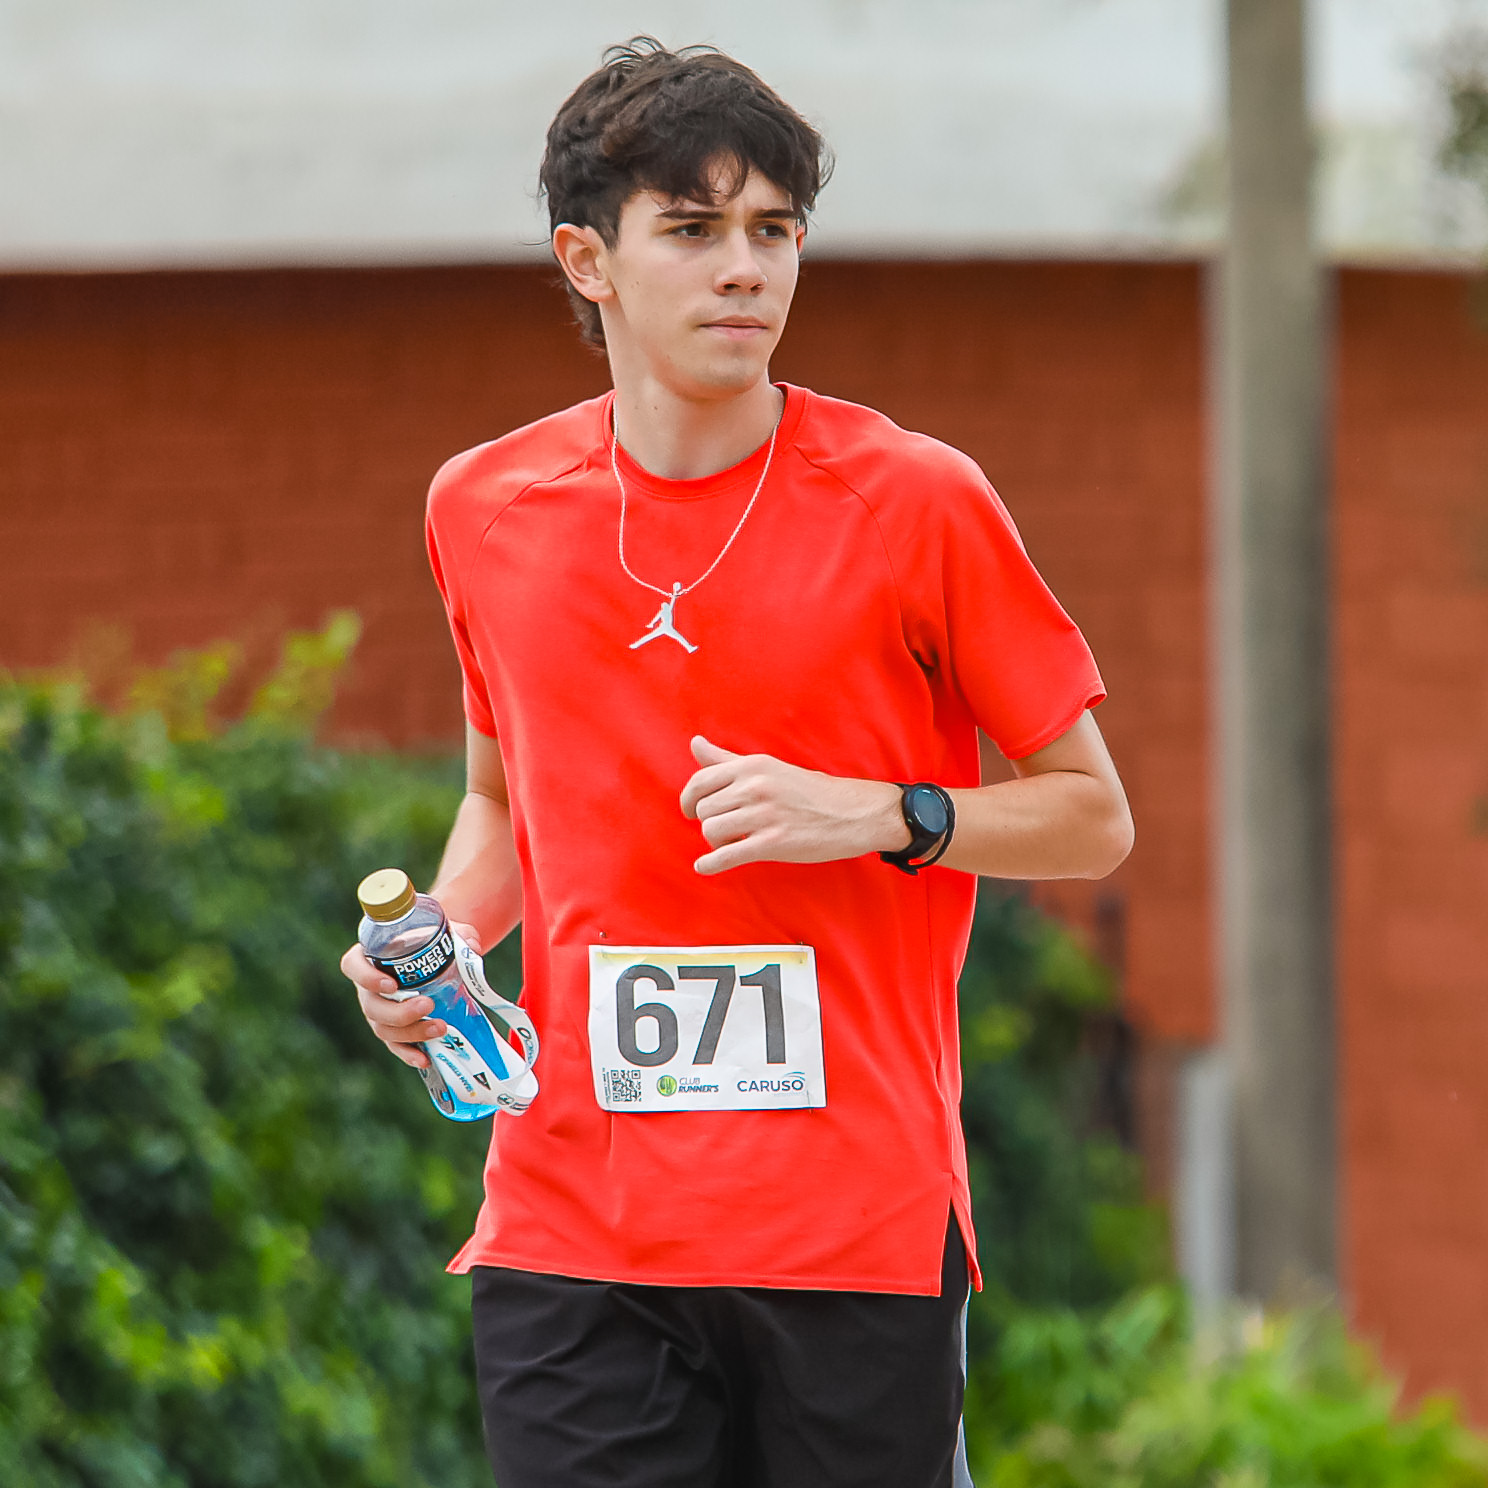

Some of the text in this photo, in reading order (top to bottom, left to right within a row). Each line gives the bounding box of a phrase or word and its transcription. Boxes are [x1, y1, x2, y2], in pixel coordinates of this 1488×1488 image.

[616, 963, 787, 1068] 671
[679, 1077, 701, 1085] CLUB
[736, 1079, 804, 1093] CARUSO
